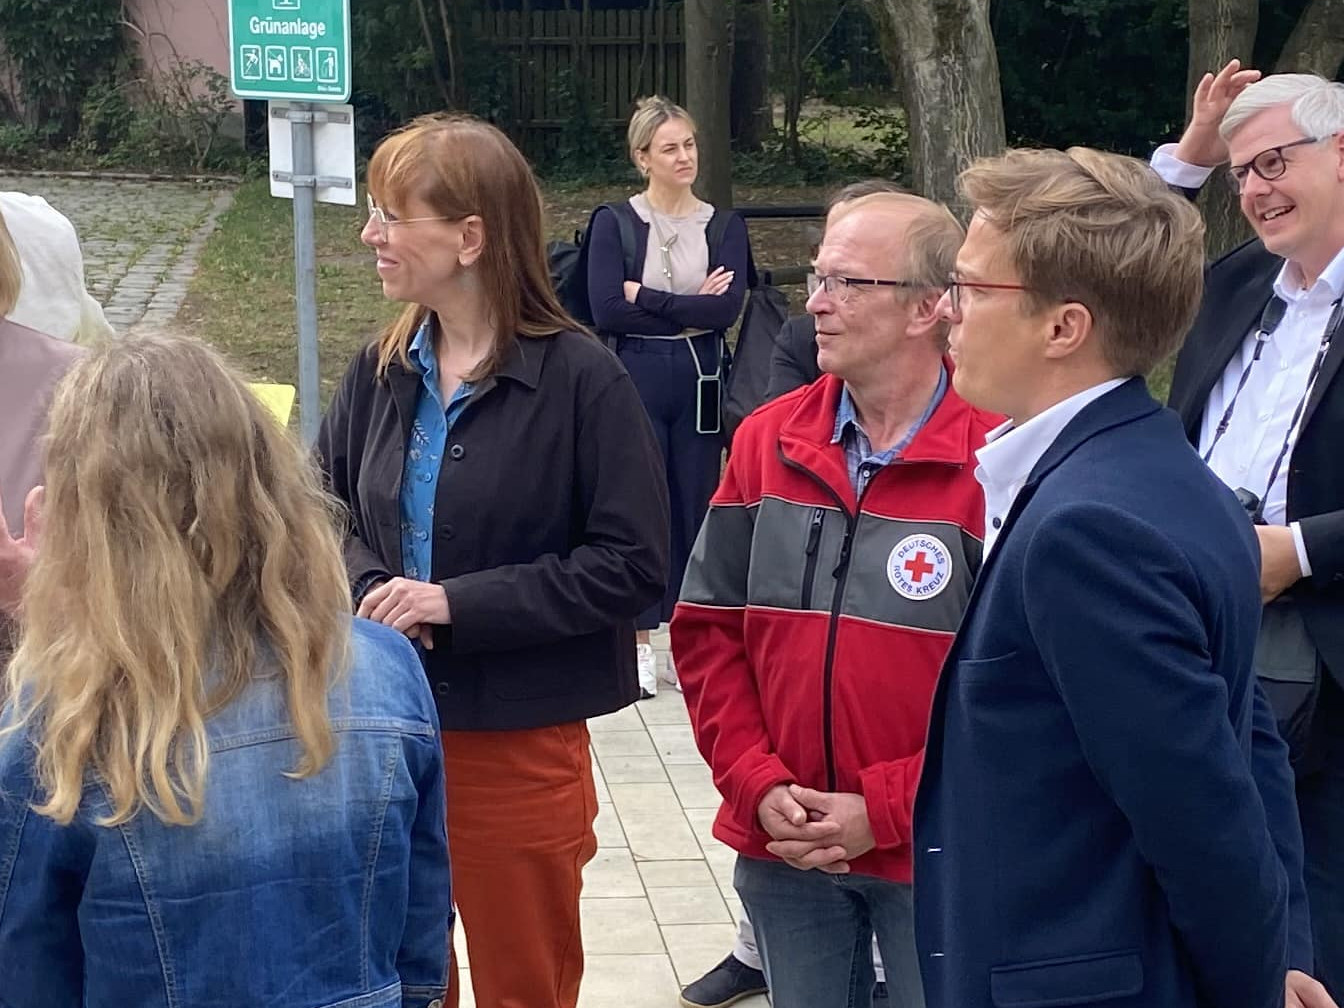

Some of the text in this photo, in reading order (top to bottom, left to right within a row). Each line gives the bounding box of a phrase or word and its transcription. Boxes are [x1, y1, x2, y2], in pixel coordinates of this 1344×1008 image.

[249, 15, 326, 39] Grünanlage
[897, 539, 945, 565] DEUTSCHES
[894, 565, 944, 594] ROTES KREUZ
